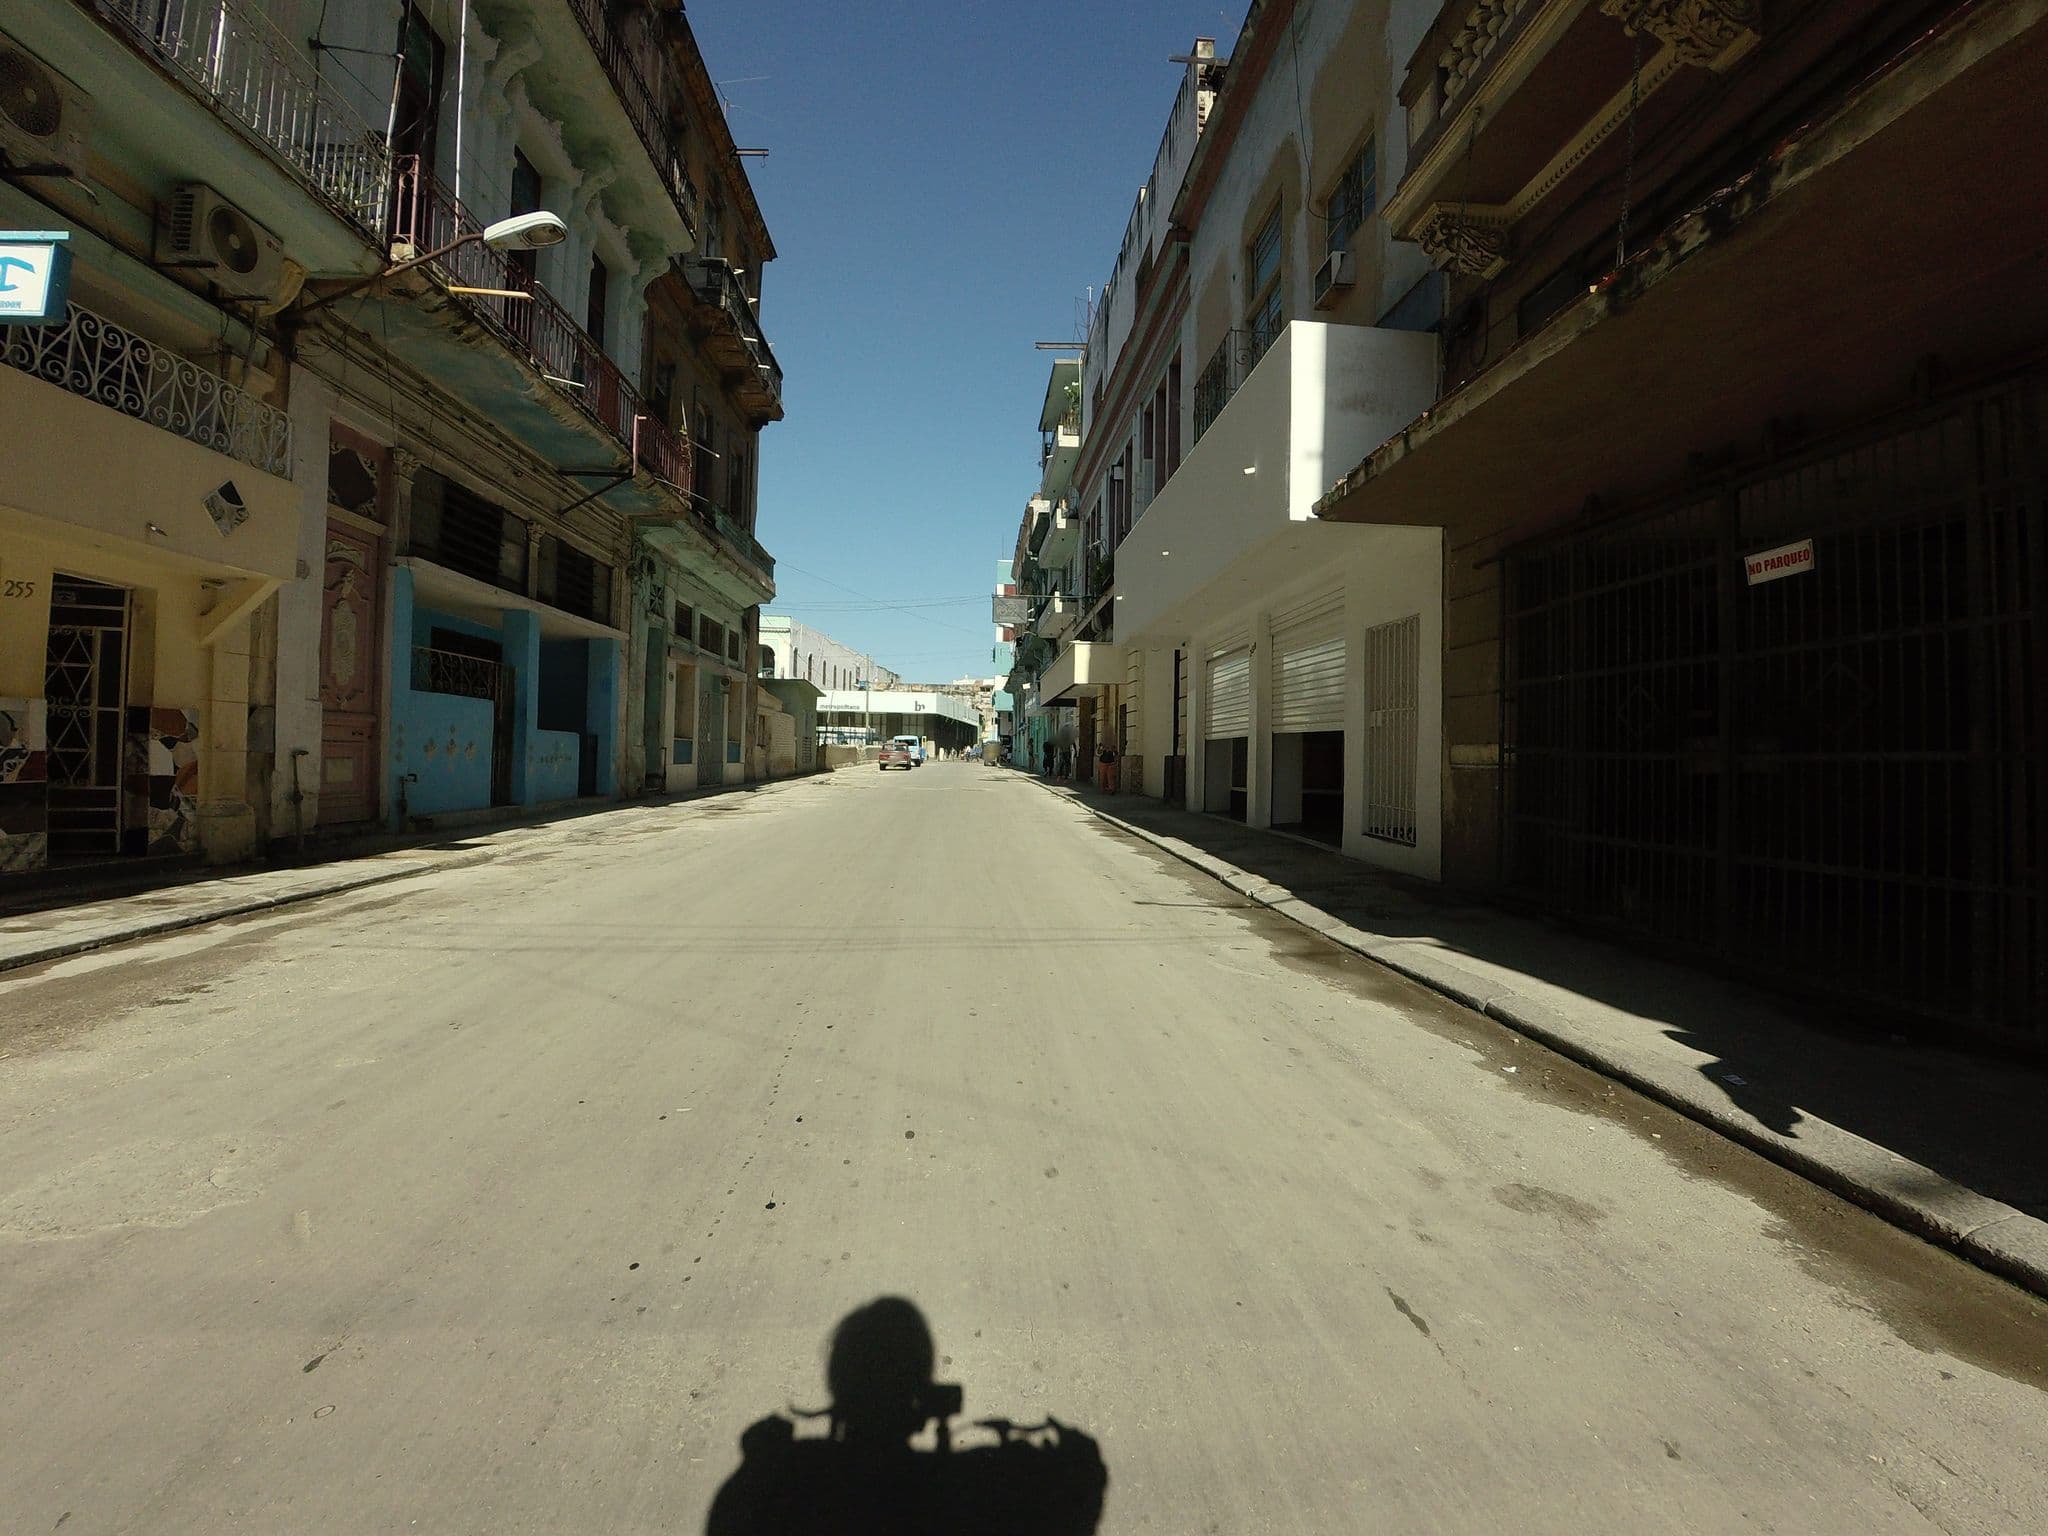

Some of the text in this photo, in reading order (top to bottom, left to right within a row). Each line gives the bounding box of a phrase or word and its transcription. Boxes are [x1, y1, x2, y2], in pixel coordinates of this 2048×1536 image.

[1748, 548, 1810, 575] NO PARQUEO
[3, 580, 35, 598] 255
